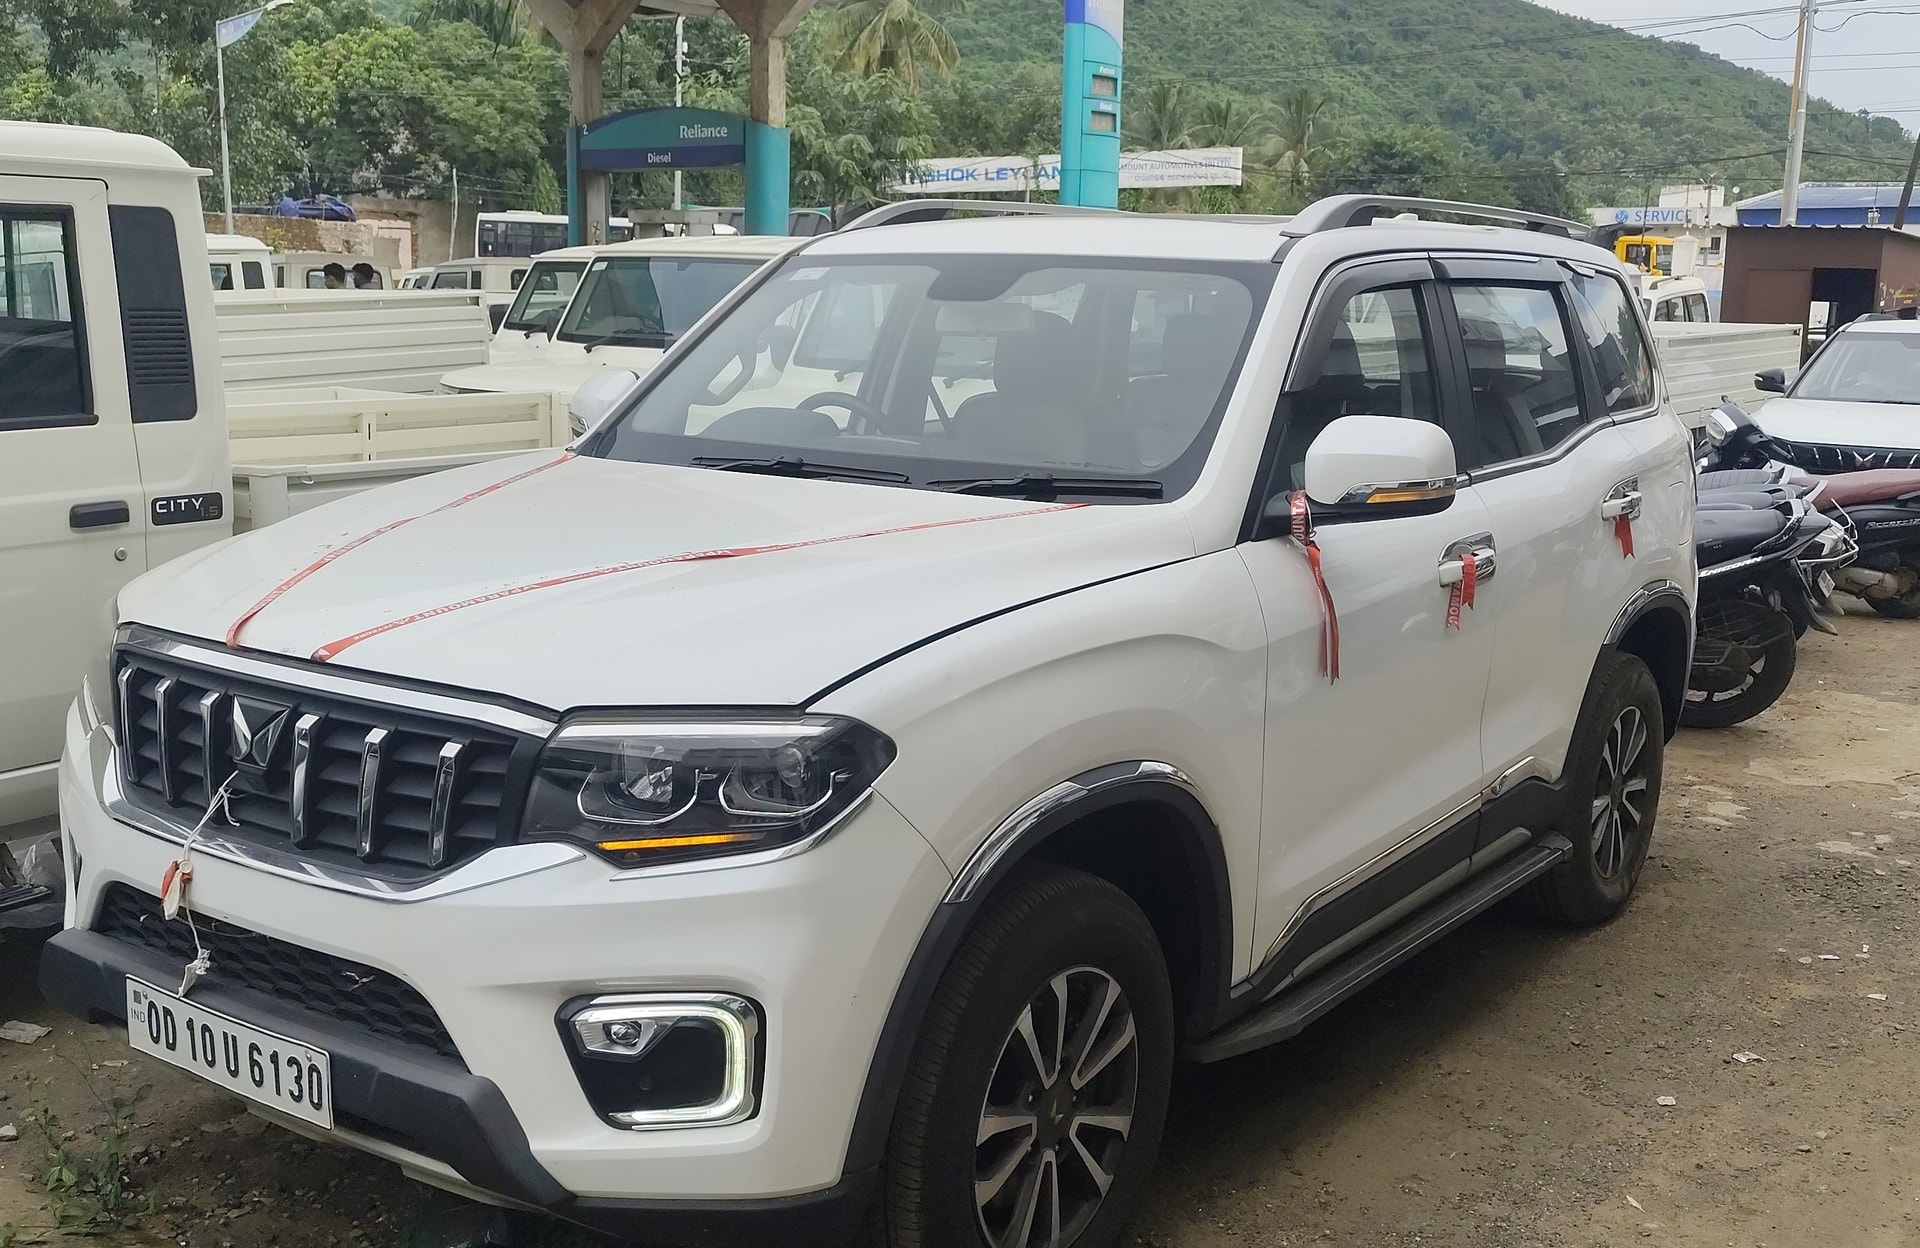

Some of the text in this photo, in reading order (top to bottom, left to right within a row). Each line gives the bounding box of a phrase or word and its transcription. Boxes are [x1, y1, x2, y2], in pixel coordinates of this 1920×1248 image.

[582, 124, 589, 135] 2
[680, 125, 728, 139] Reliance
[647, 152, 672, 163] Diesel
[156, 497, 218, 517] CITY 1.5
[131, 1008, 146, 1024] IND
[148, 1000, 322, 1111] OD 10 U 6130
